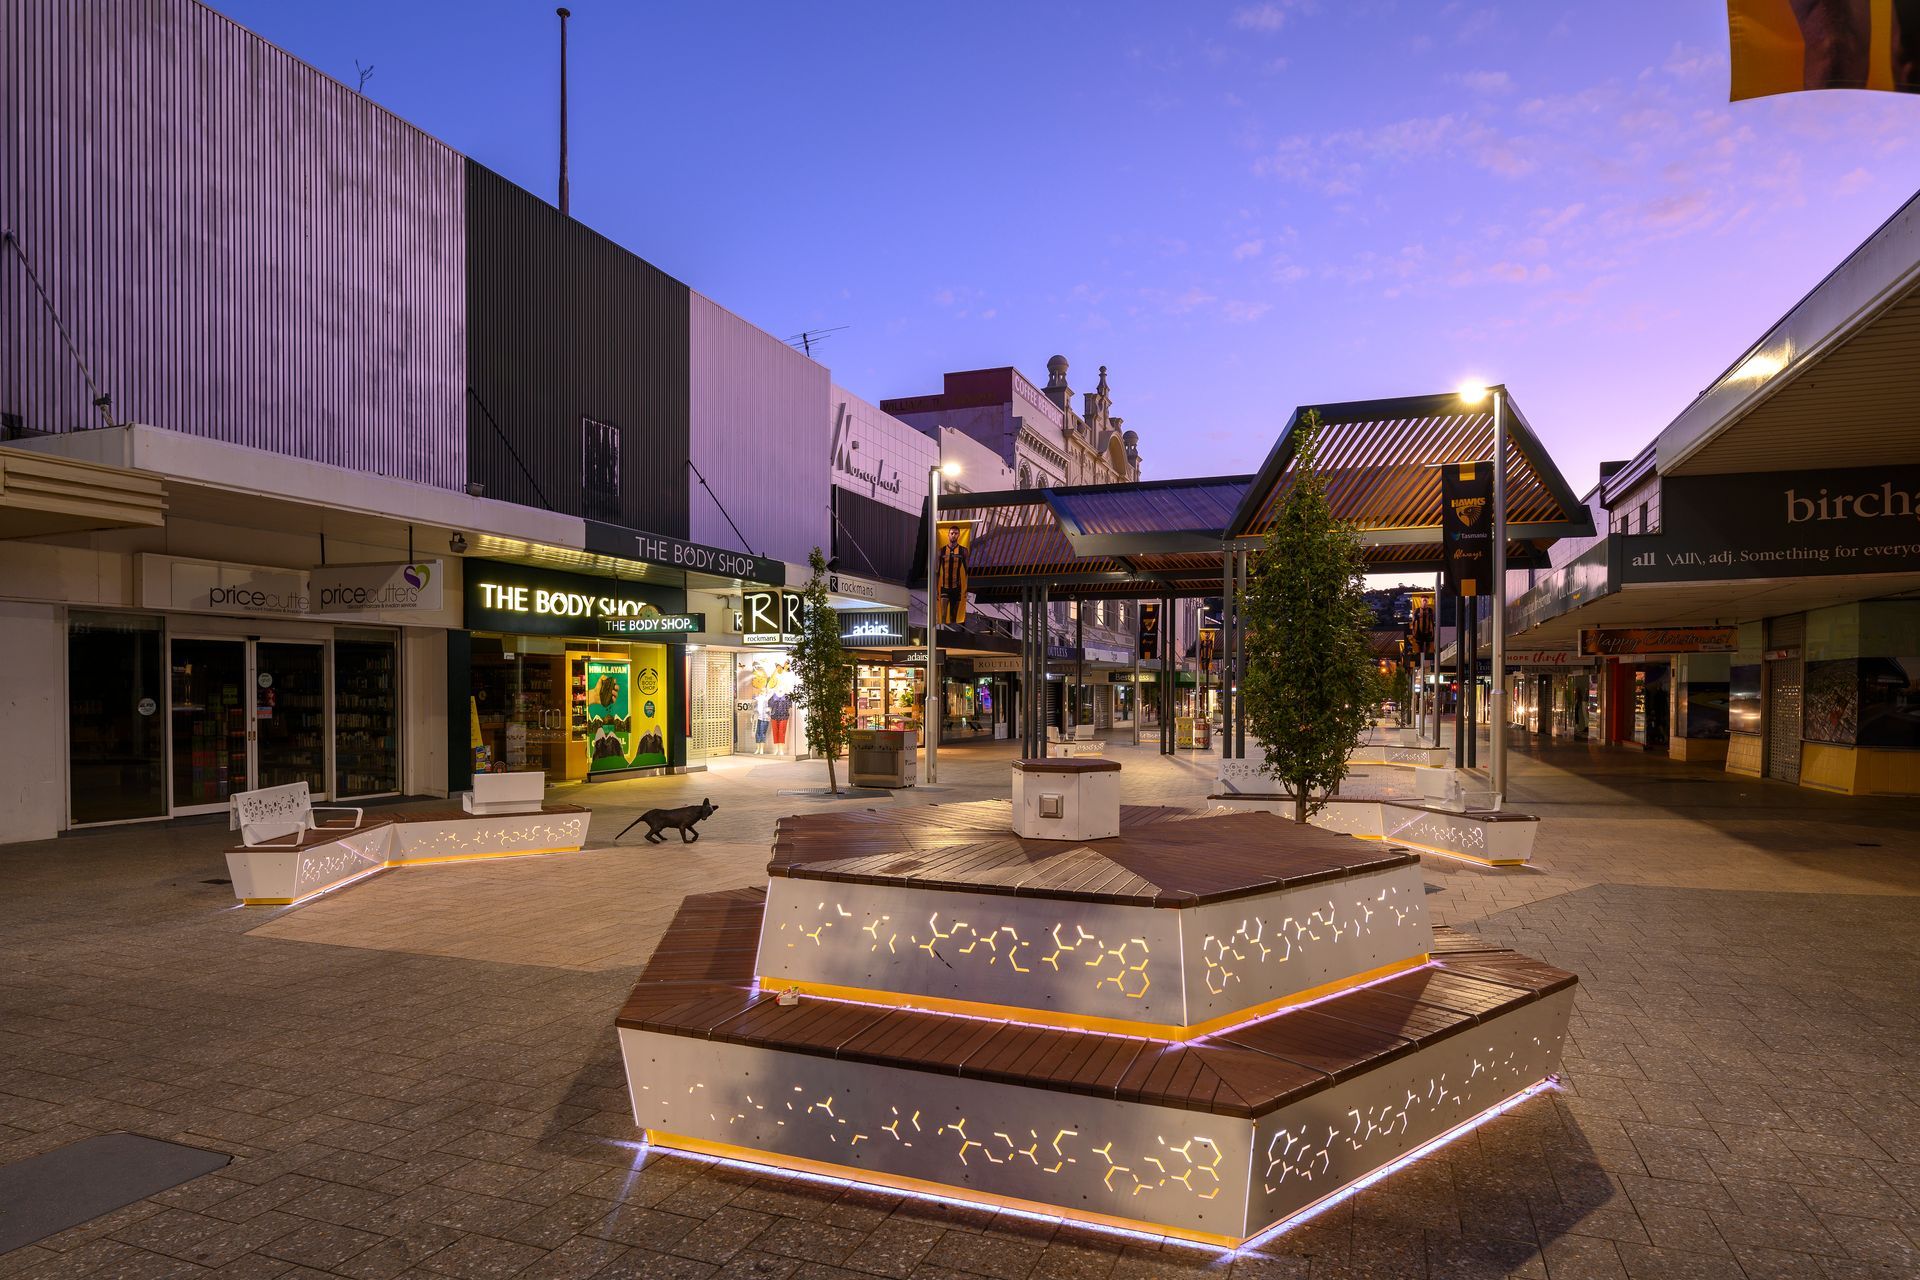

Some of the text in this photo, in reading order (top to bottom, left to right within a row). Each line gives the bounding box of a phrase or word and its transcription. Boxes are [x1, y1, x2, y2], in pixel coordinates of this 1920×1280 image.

[1014, 375, 1038, 407] COFFEE
[1451, 497, 1486, 508] HAWKS
[1461, 532, 1487, 540] Tasmania
[635, 536, 668, 561] THE
[674, 544, 717, 568] BODY
[1632, 552, 1656, 566] all
[1709, 551, 1737, 566] adj.
[1740, 546, 1830, 562] Something
[1835, 545, 1859, 558] for
[831, 577, 874, 597] R rockmans
[210, 584, 310, 609] pricecutte
[321, 583, 417, 609] pricecutters
[480, 583, 529, 612] THE
[535, 589, 596, 618] BODY
[744, 593, 778, 633] R
[783, 595, 803, 632] R
[606, 620, 626, 631] THE
[629, 619, 659, 631] BODY
[852, 621, 889, 636] adairs
[747, 634, 777, 642] rockmans
[1583, 631, 1639, 652] Happy
[907, 652, 929, 662] adairs
[1047, 646, 1068, 658] OUTLEYS
[1532, 651, 1567, 664] thrift
[588, 665, 628, 674] HIMALAYAN
[978, 660, 1020, 670] ROUTLEY
